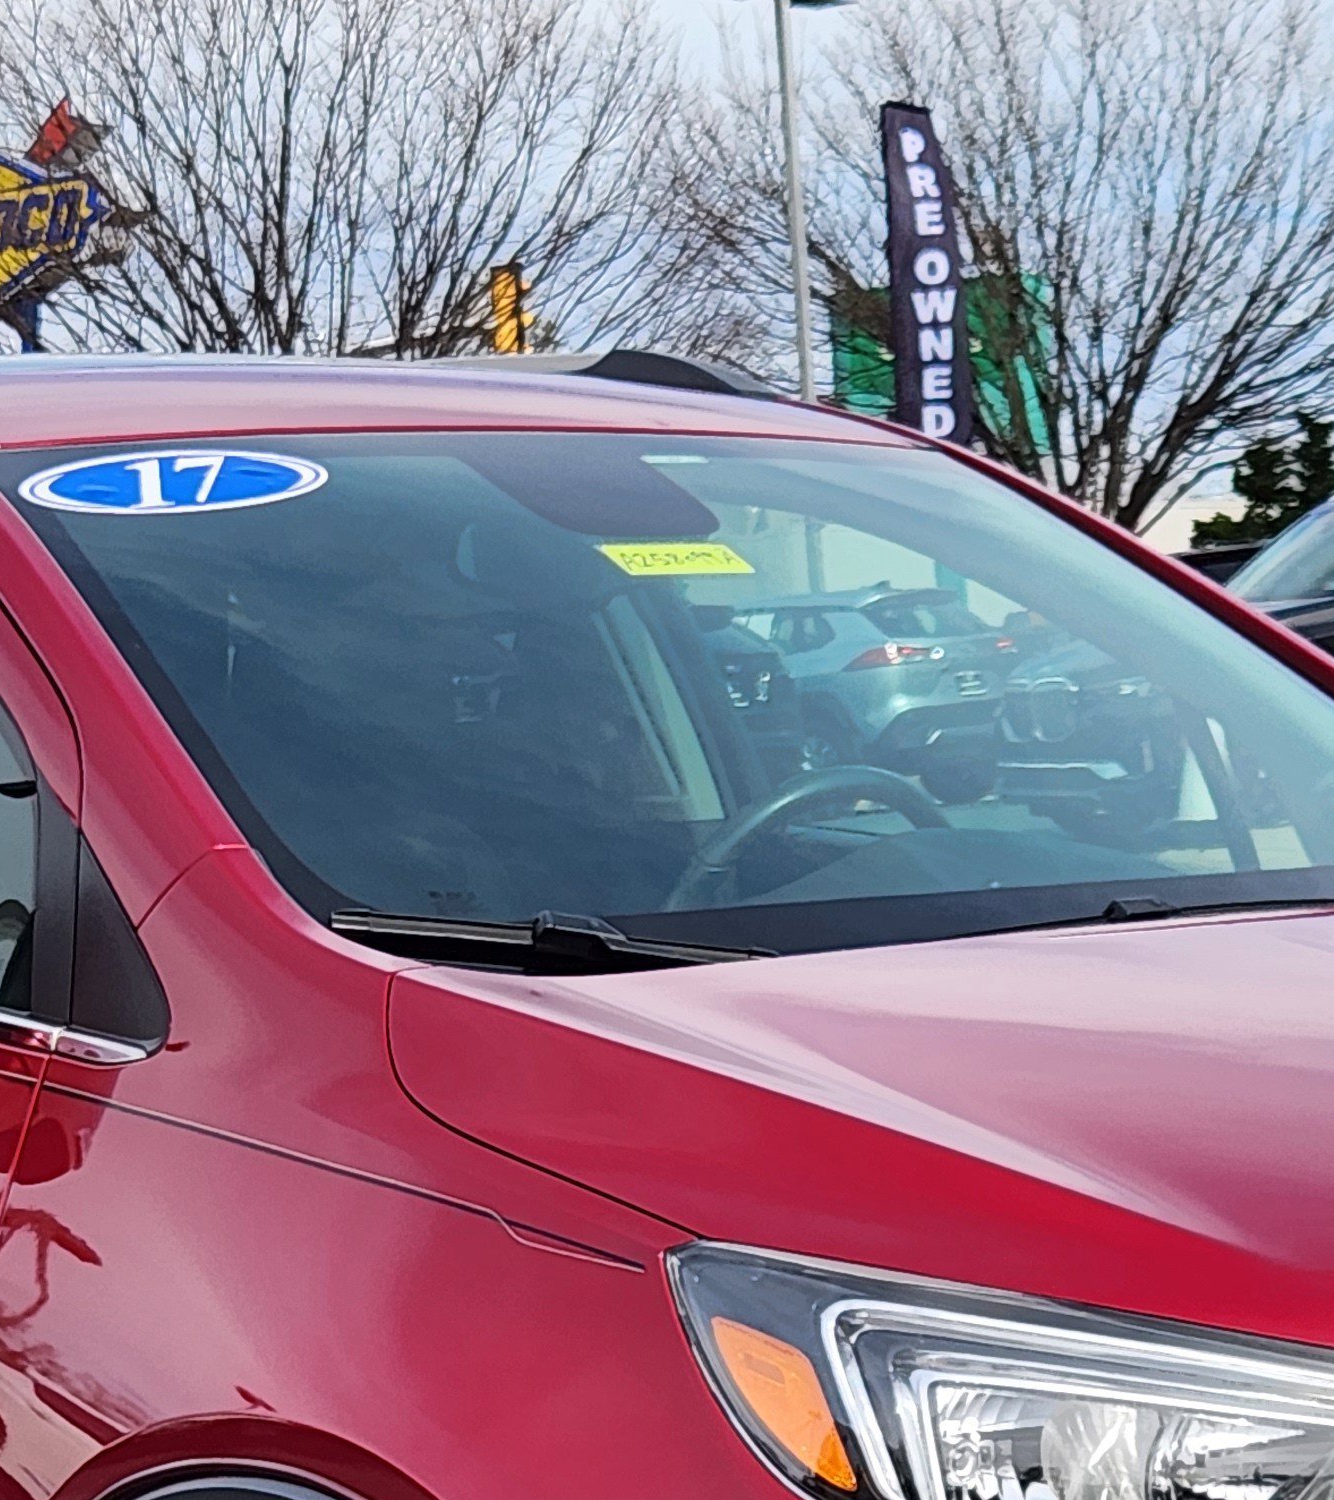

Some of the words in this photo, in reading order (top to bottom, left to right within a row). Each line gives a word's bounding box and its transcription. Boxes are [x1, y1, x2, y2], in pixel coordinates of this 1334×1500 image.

[899, 126, 945, 237] PRE
[909, 247, 957, 438] OWNED
[124, 454, 225, 508] 17
